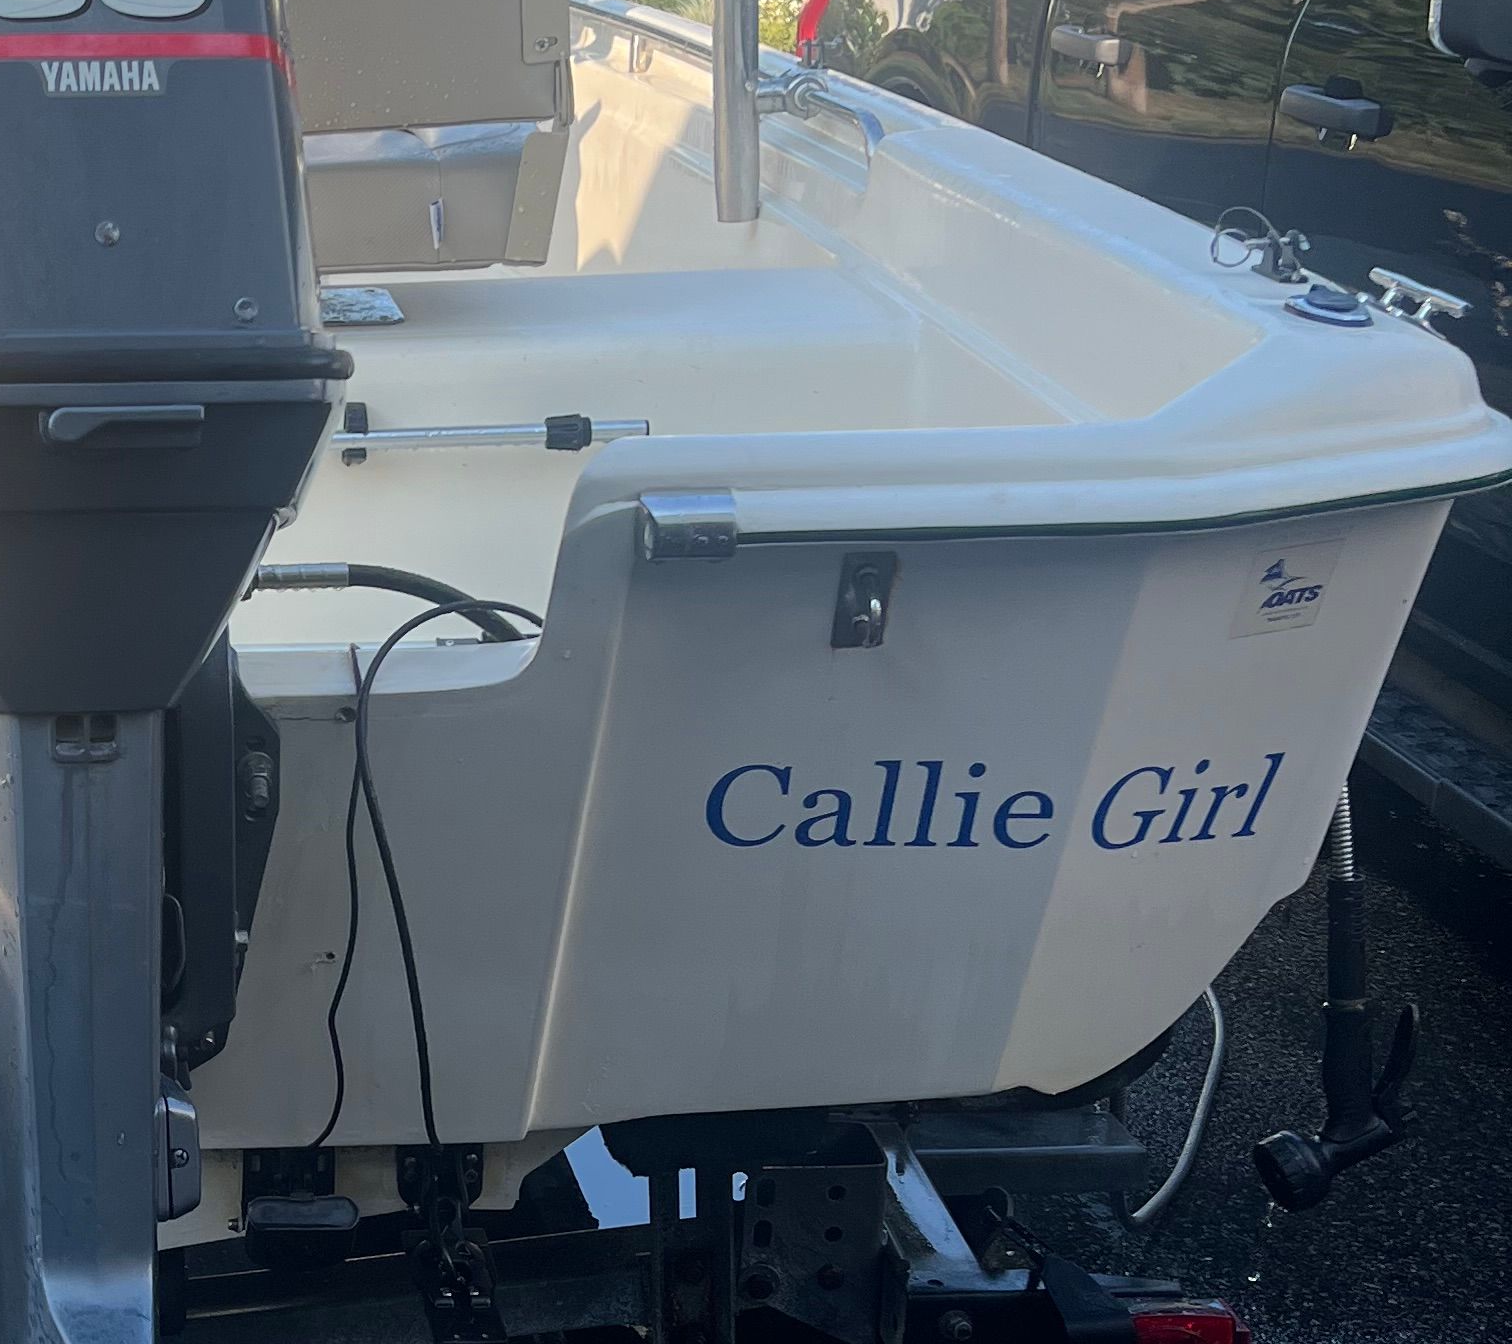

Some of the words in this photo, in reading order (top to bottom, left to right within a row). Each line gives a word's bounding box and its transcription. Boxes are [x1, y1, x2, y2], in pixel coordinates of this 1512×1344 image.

[40, 60, 160, 92] YAMAHA
[705, 759, 1055, 849] Callie
[1090, 752, 1286, 850] Girl
